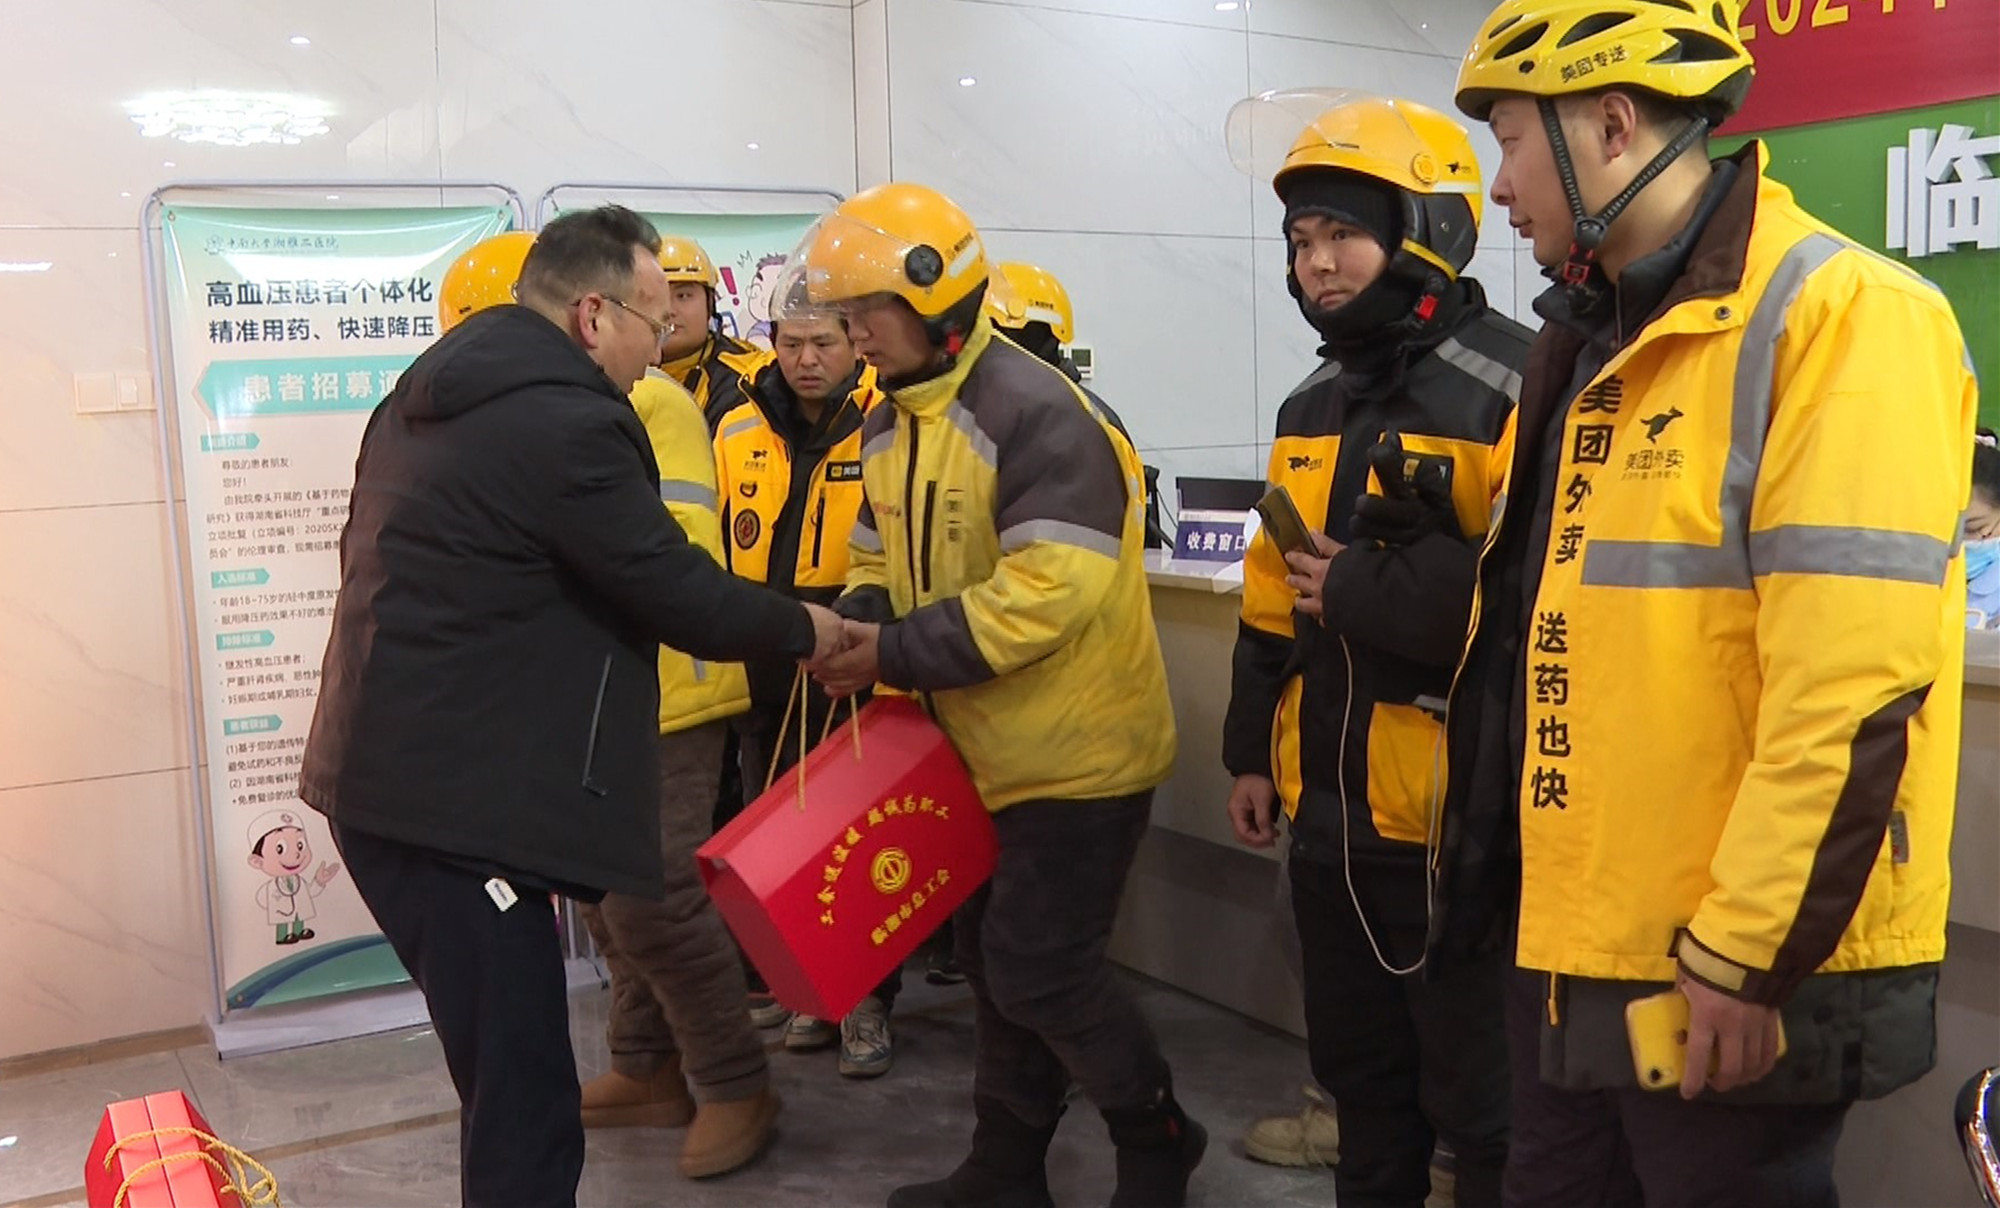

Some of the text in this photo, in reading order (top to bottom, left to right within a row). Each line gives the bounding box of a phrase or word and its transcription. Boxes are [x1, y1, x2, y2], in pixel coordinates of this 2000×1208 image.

[206, 277, 433, 307] 高血压患者个体化
[208, 315, 435, 344] 精准用药、快速降压
[1186, 530, 1246, 552] 收费窗口
[1530, 374, 1624, 810] 美团外卖 送药也快
